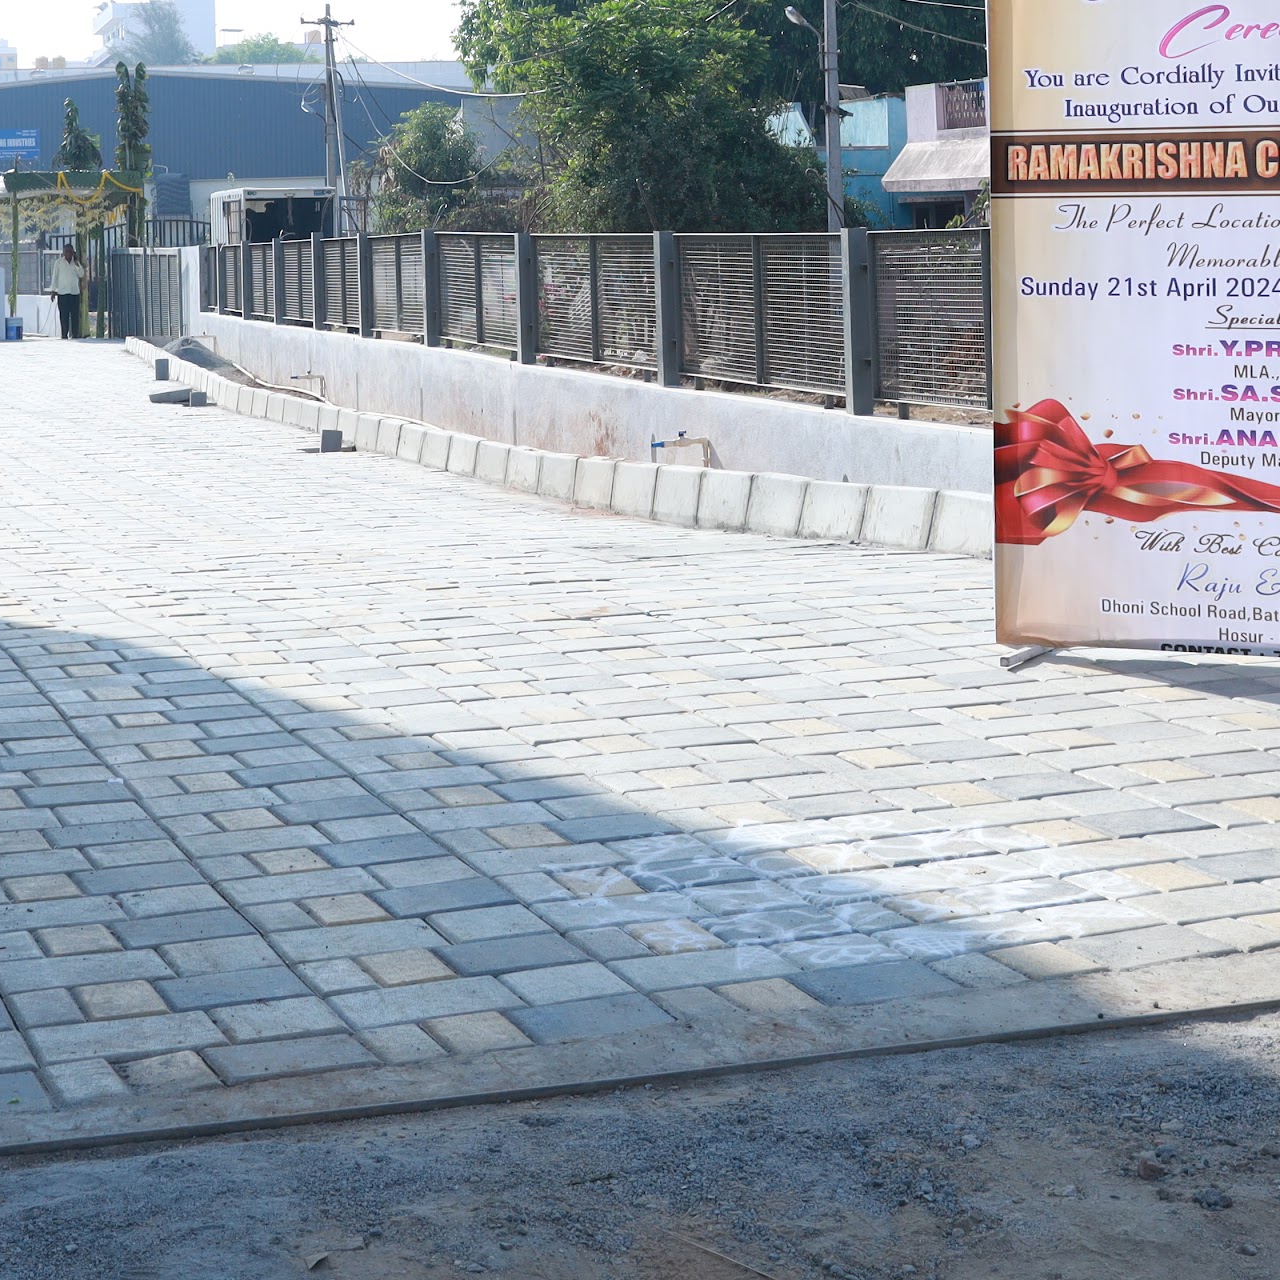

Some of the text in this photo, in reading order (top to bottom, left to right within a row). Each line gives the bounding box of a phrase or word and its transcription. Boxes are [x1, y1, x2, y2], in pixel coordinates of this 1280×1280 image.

[1024, 69, 1064, 87] You
[1074, 70, 1110, 86] are
[1120, 63, 1224, 90] Cordially
[1065, 97, 1199, 124] Inauguration
[1209, 94, 1236, 115] of
[1007, 140, 1249, 182] RAMAKRISHNA
[1054, 203, 1099, 230] The
[1105, 203, 1185, 236] Perfect
[1020, 276, 1099, 301] Sunday
[1107, 276, 1158, 297] 21st
[1166, 276, 1218, 301] April
[1200, 451, 1256, 468] Deputy
[1134, 530, 1186, 553] With
[1193, 533, 1243, 555] Best
[1176, 562, 1243, 602] Raju
[1101, 598, 1145, 615] Dhoni
[1150, 601, 1202, 618] School
[1218, 627, 1264, 644] Hosur
